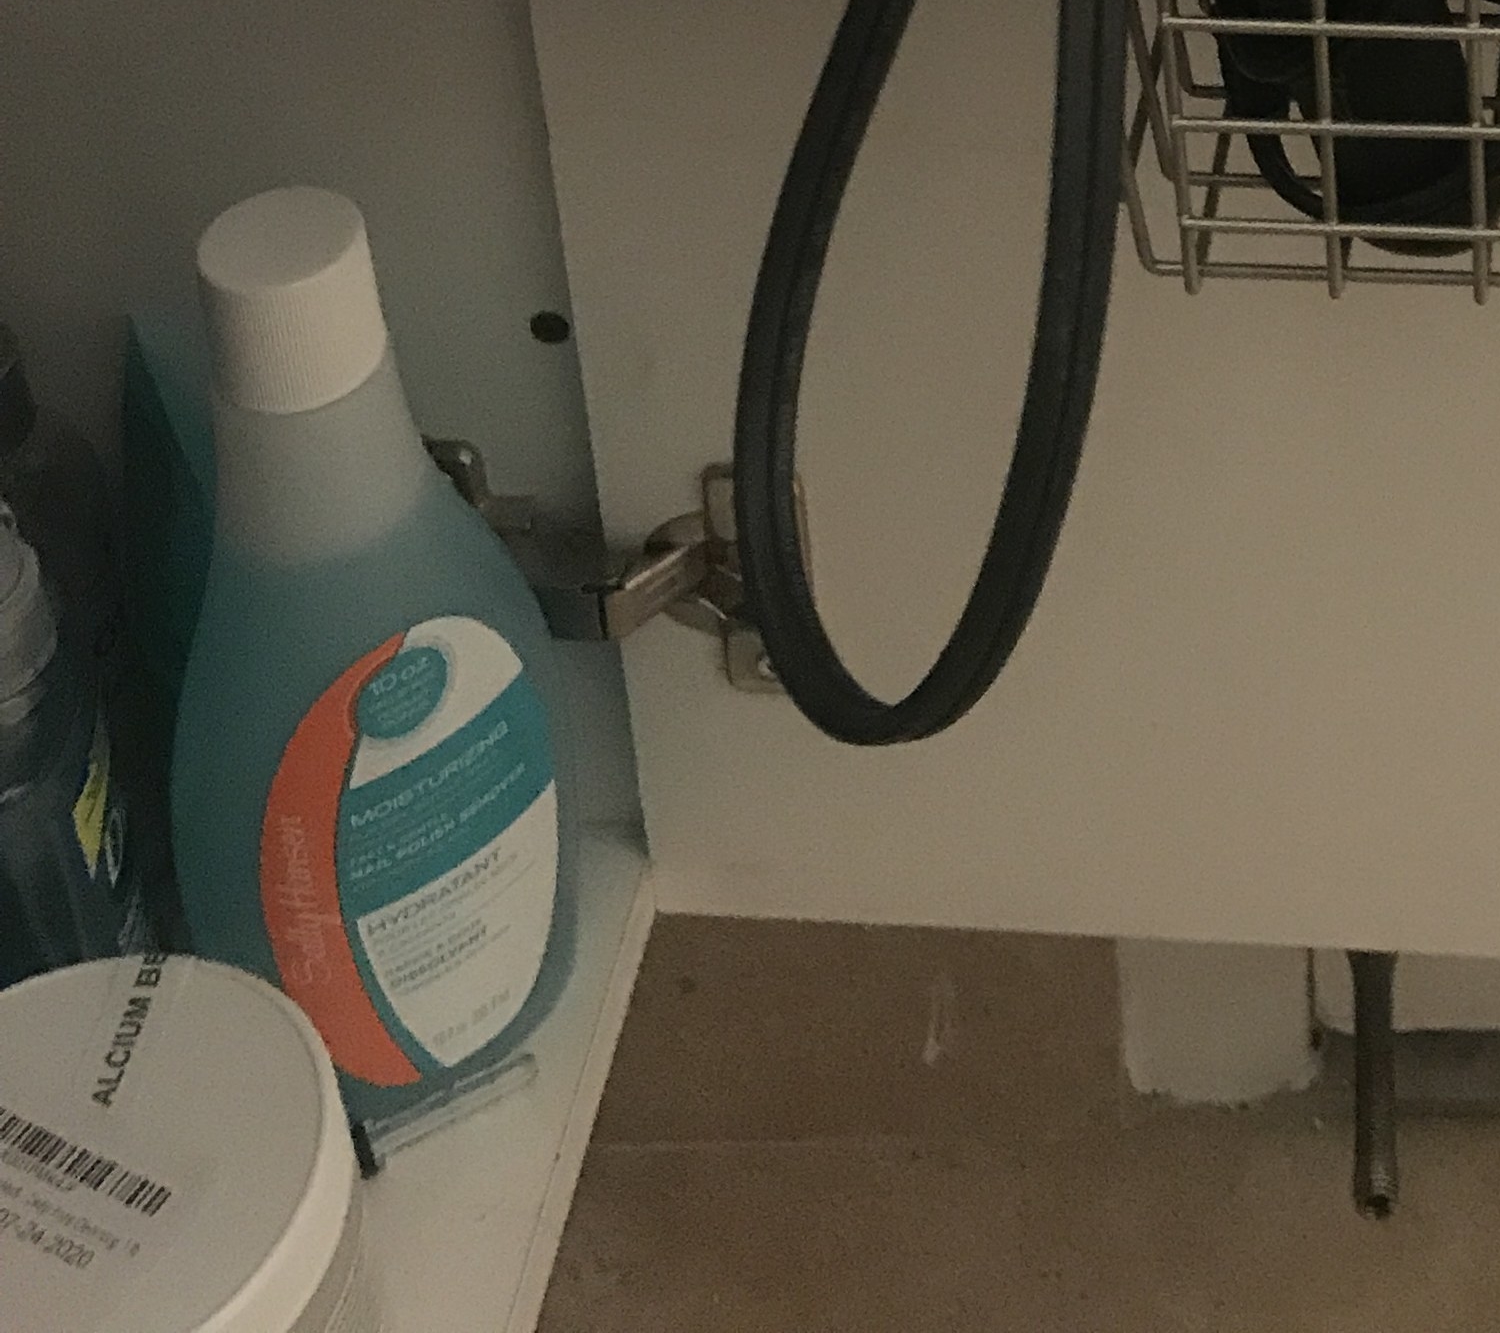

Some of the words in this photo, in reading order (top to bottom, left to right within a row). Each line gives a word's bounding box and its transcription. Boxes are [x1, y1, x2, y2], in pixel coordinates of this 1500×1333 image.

[350, 719, 509, 827] MOISTURIZING
[366, 846, 503, 936] HYDRATANT
[91, 995, 153, 1109] ALCIUM
